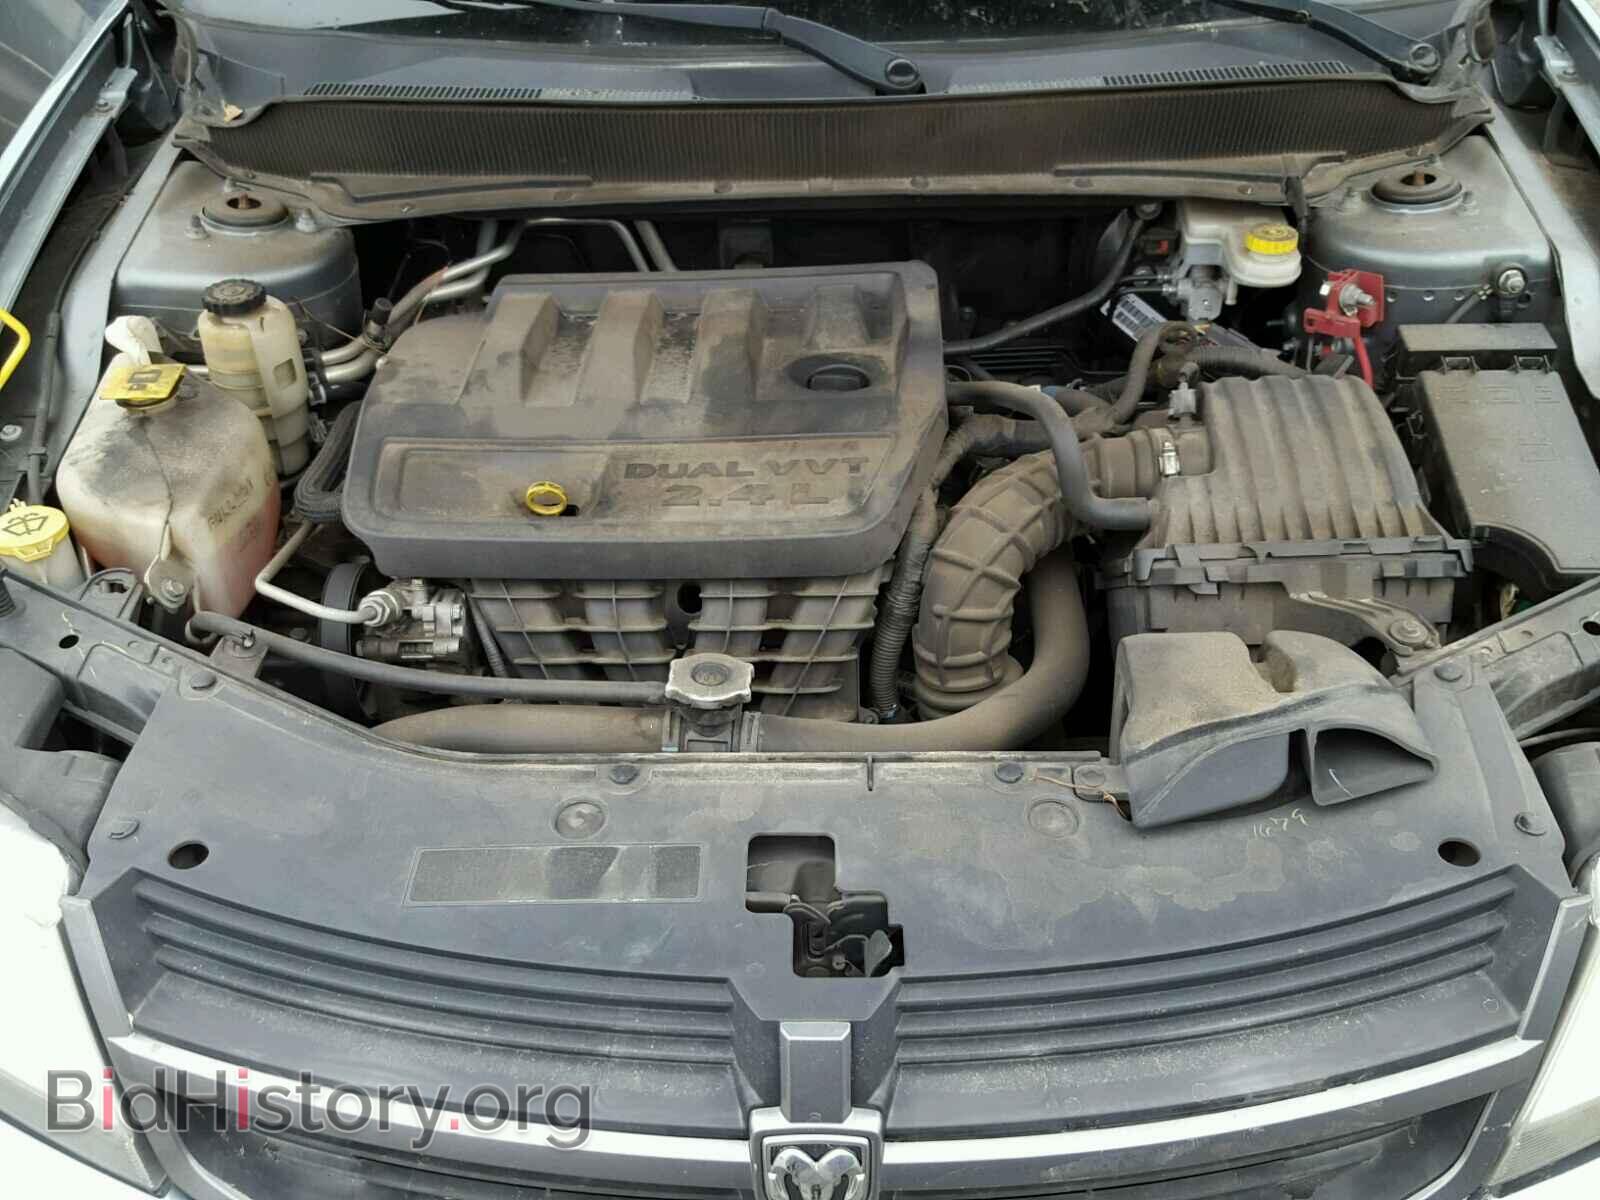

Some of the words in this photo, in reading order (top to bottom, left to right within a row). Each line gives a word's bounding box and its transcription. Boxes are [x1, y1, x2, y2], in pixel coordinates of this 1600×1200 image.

[624, 460, 754, 480] DUAL
[766, 456, 869, 476] VVT
[662, 483, 829, 507] 2.4L
